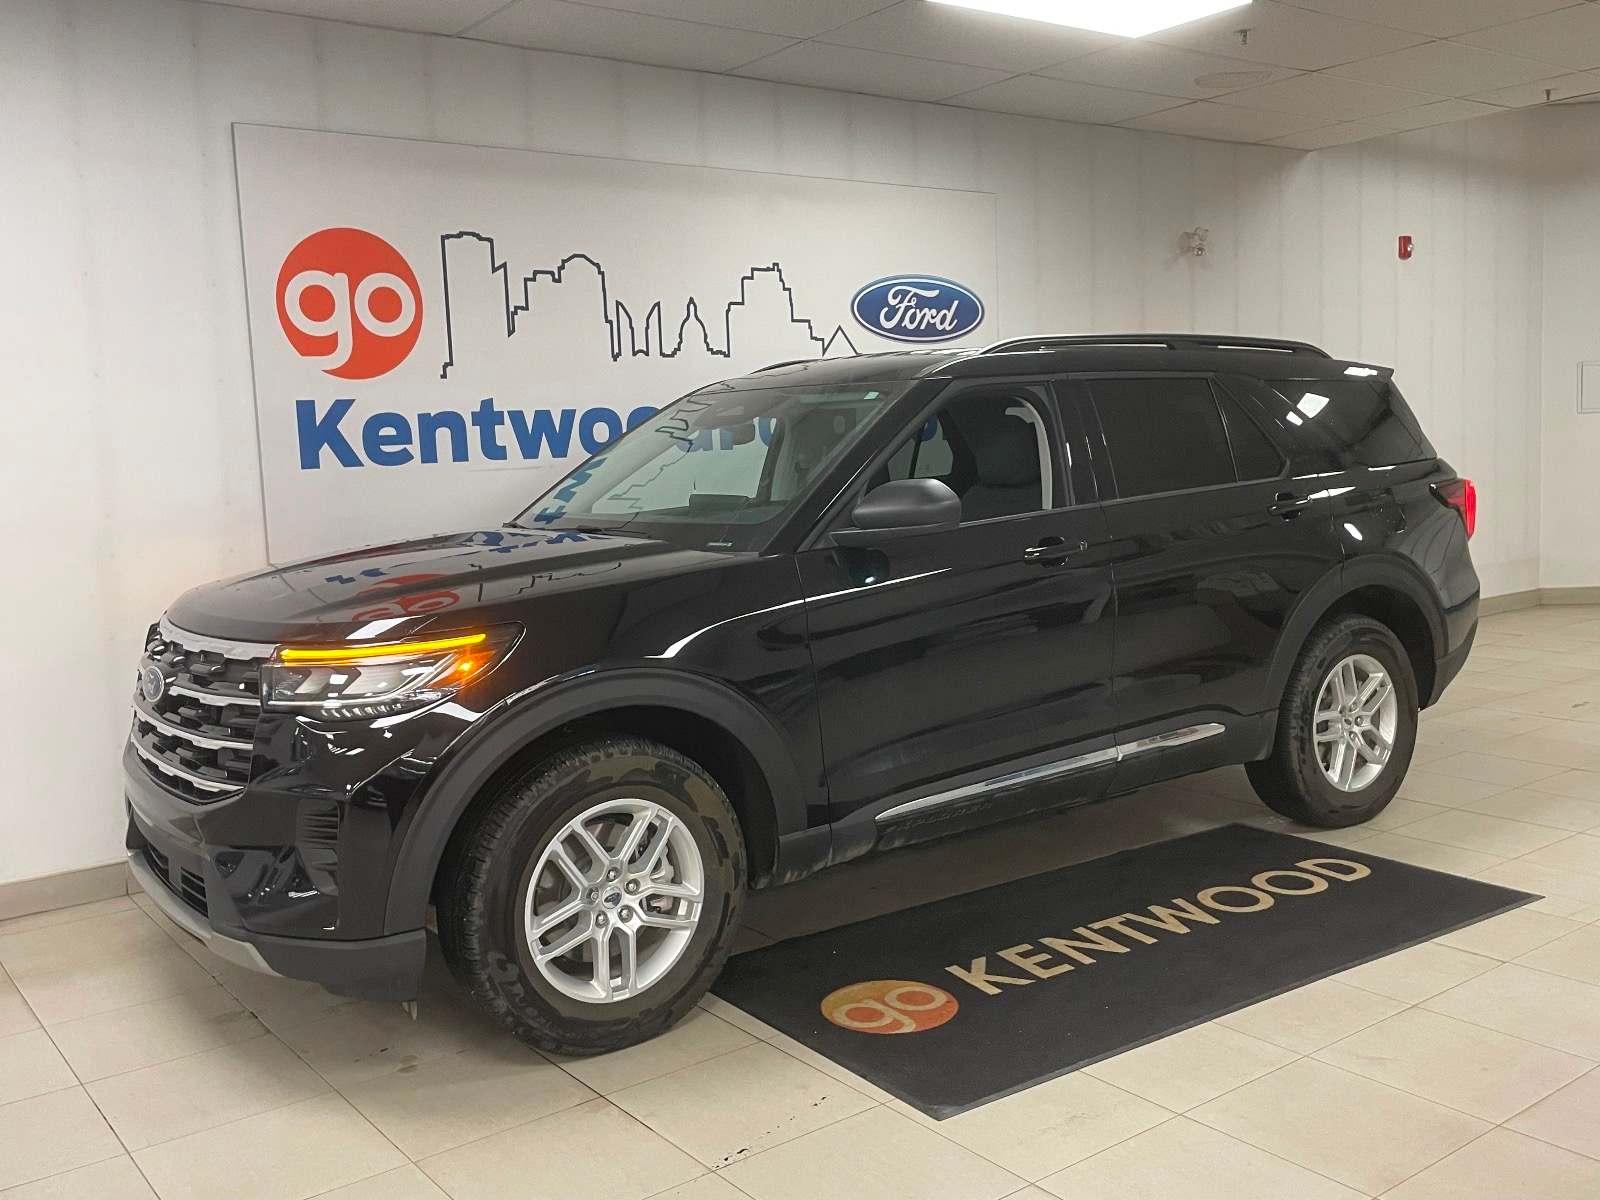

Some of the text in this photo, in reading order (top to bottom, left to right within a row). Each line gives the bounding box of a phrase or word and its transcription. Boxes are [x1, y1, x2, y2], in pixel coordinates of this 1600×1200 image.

[283, 269, 417, 371] go
[880, 286, 959, 331] Ford
[833, 858, 1372, 1034] go KENTWOOD
